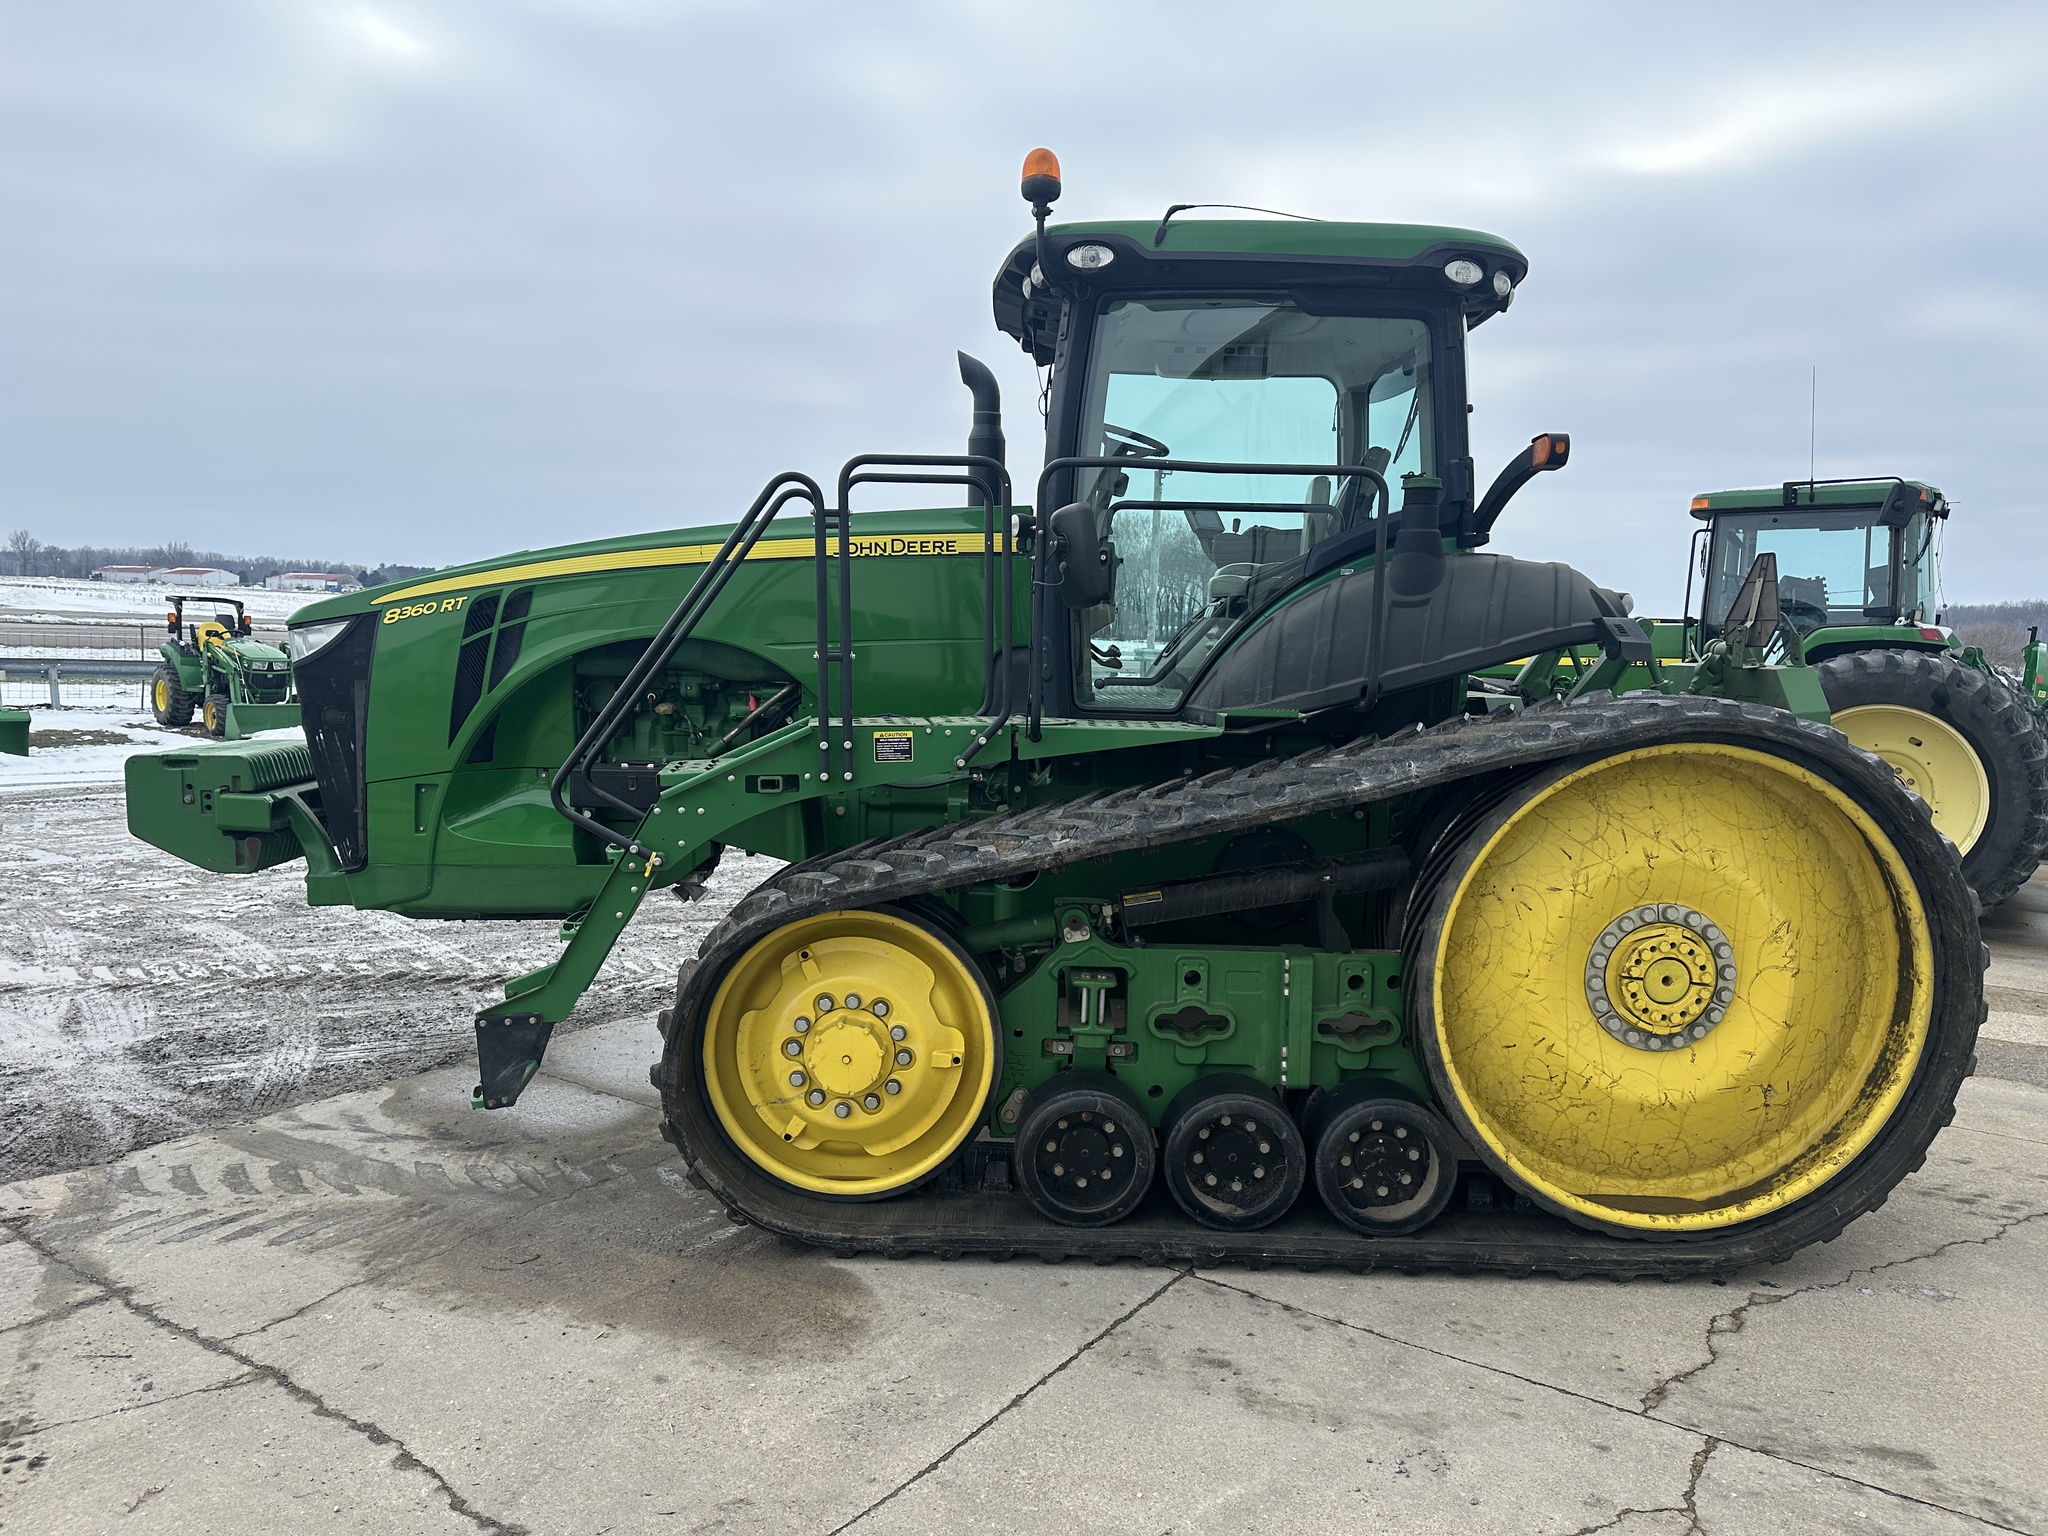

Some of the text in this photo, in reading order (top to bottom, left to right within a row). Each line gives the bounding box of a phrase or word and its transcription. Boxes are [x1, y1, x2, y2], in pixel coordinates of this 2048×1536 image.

[833, 538, 957, 555] OHN DEERE
[383, 596, 468, 624] 8360 RT
